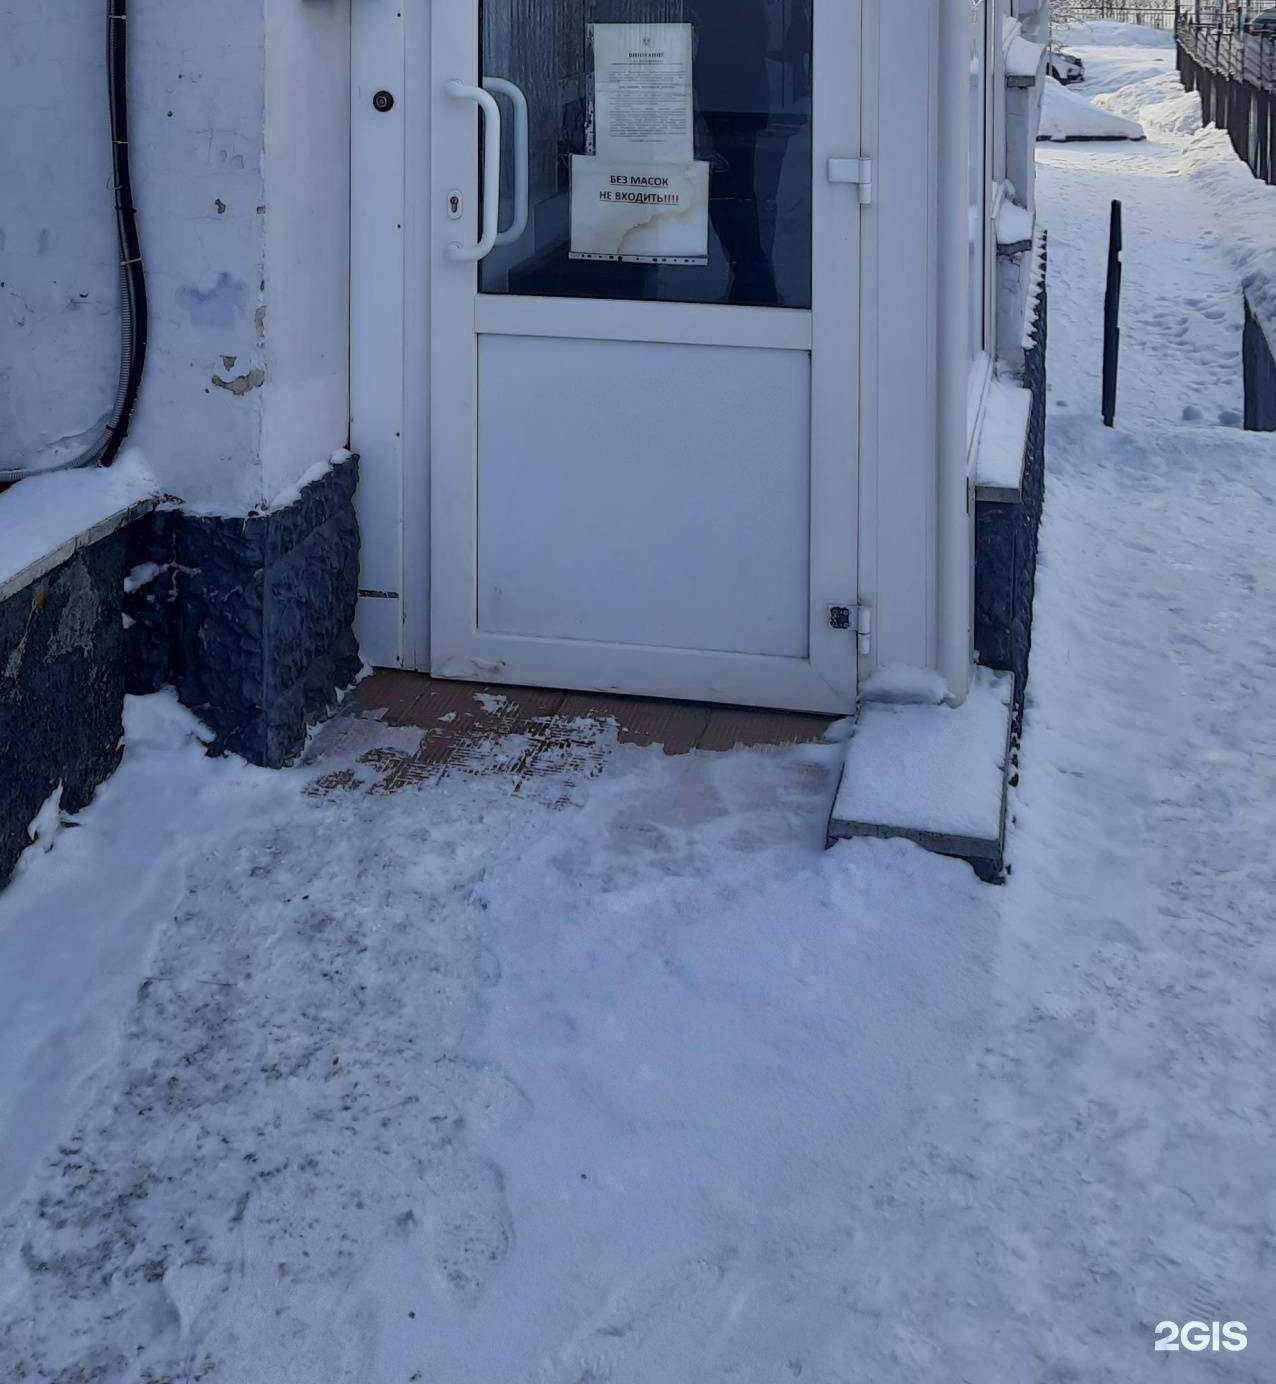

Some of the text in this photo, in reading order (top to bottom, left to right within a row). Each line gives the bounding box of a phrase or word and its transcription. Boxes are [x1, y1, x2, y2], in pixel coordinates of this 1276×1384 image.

[610, 175, 669, 186] БЕЗ МАСОК
[599, 191, 679, 204] НЕ ВХОДИТЬ!!!!
